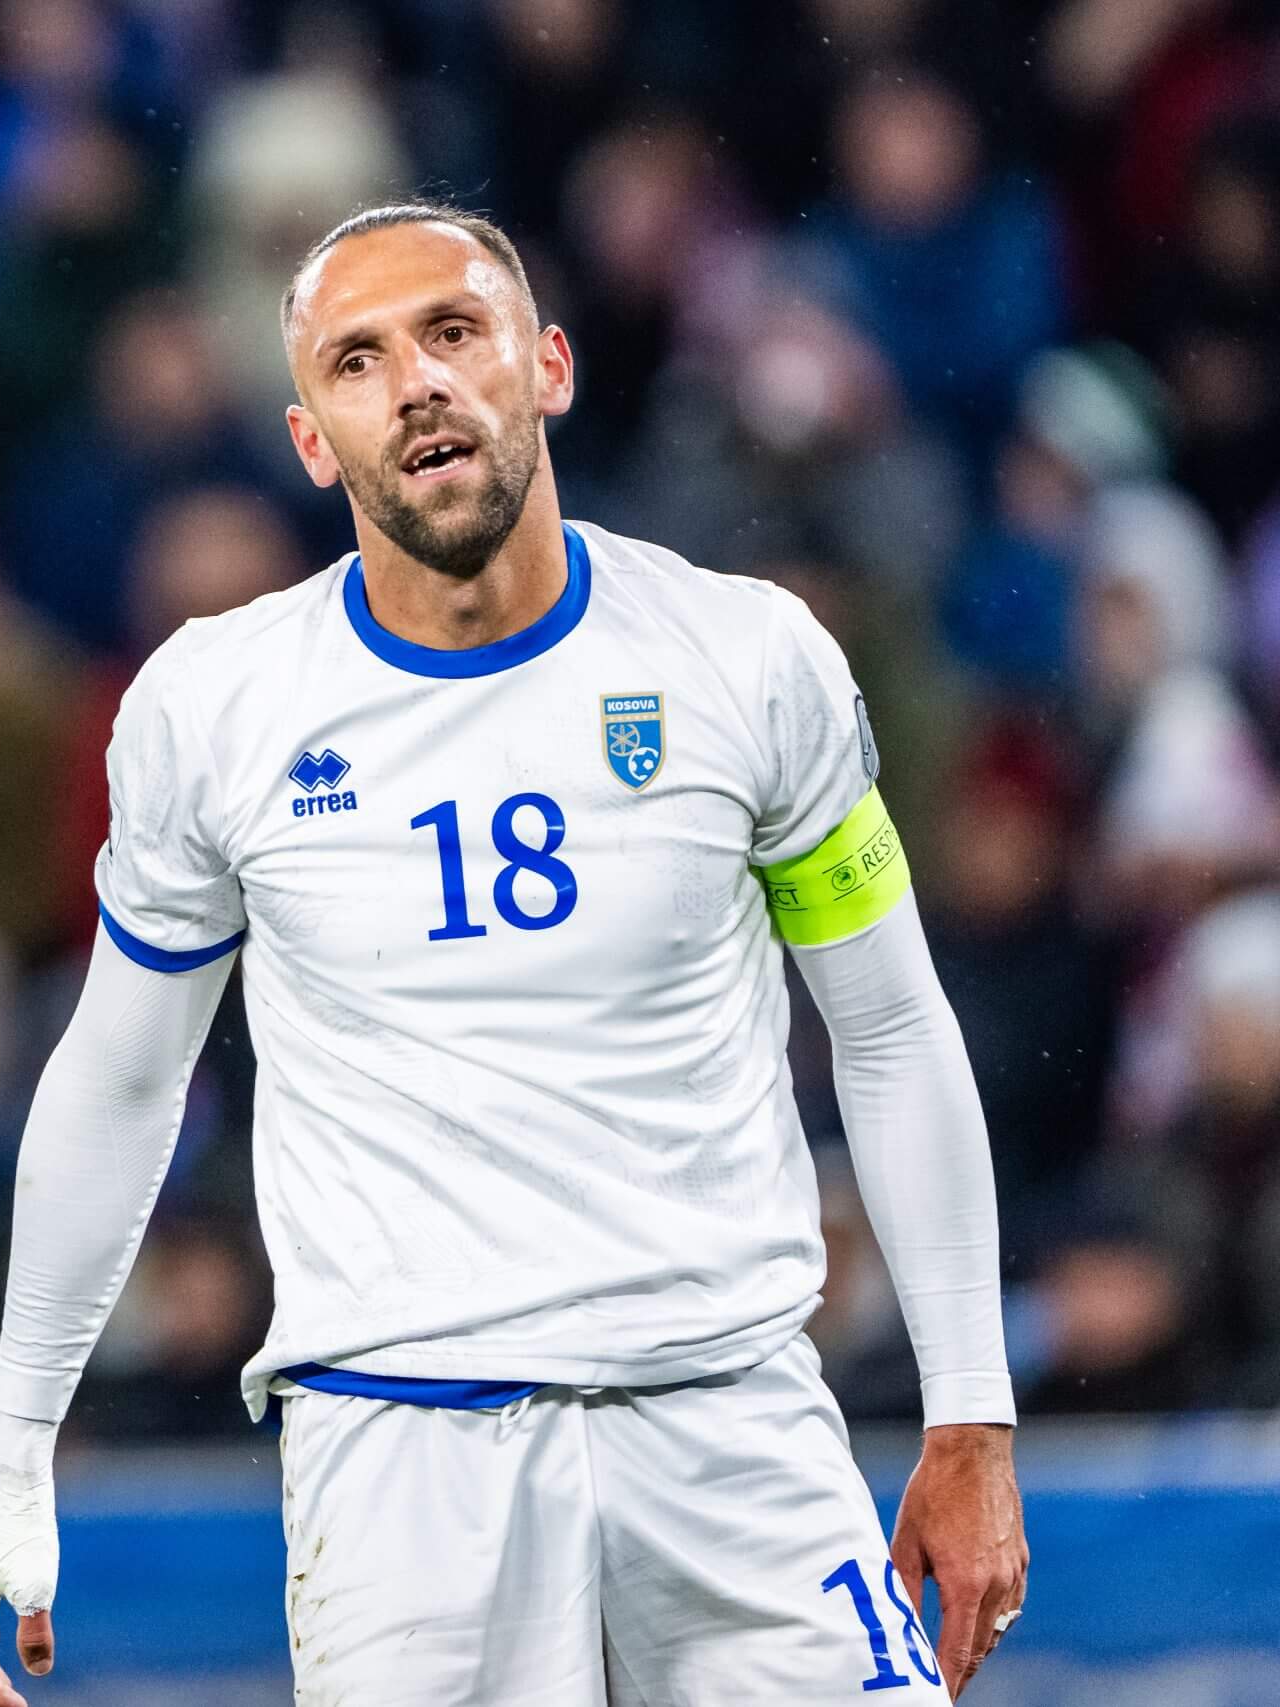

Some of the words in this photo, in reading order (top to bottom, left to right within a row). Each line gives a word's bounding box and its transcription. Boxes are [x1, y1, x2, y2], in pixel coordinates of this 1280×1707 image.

[607, 698, 657, 712] KOSOVA
[291, 789, 358, 818] errea
[410, 792, 578, 941] 18
